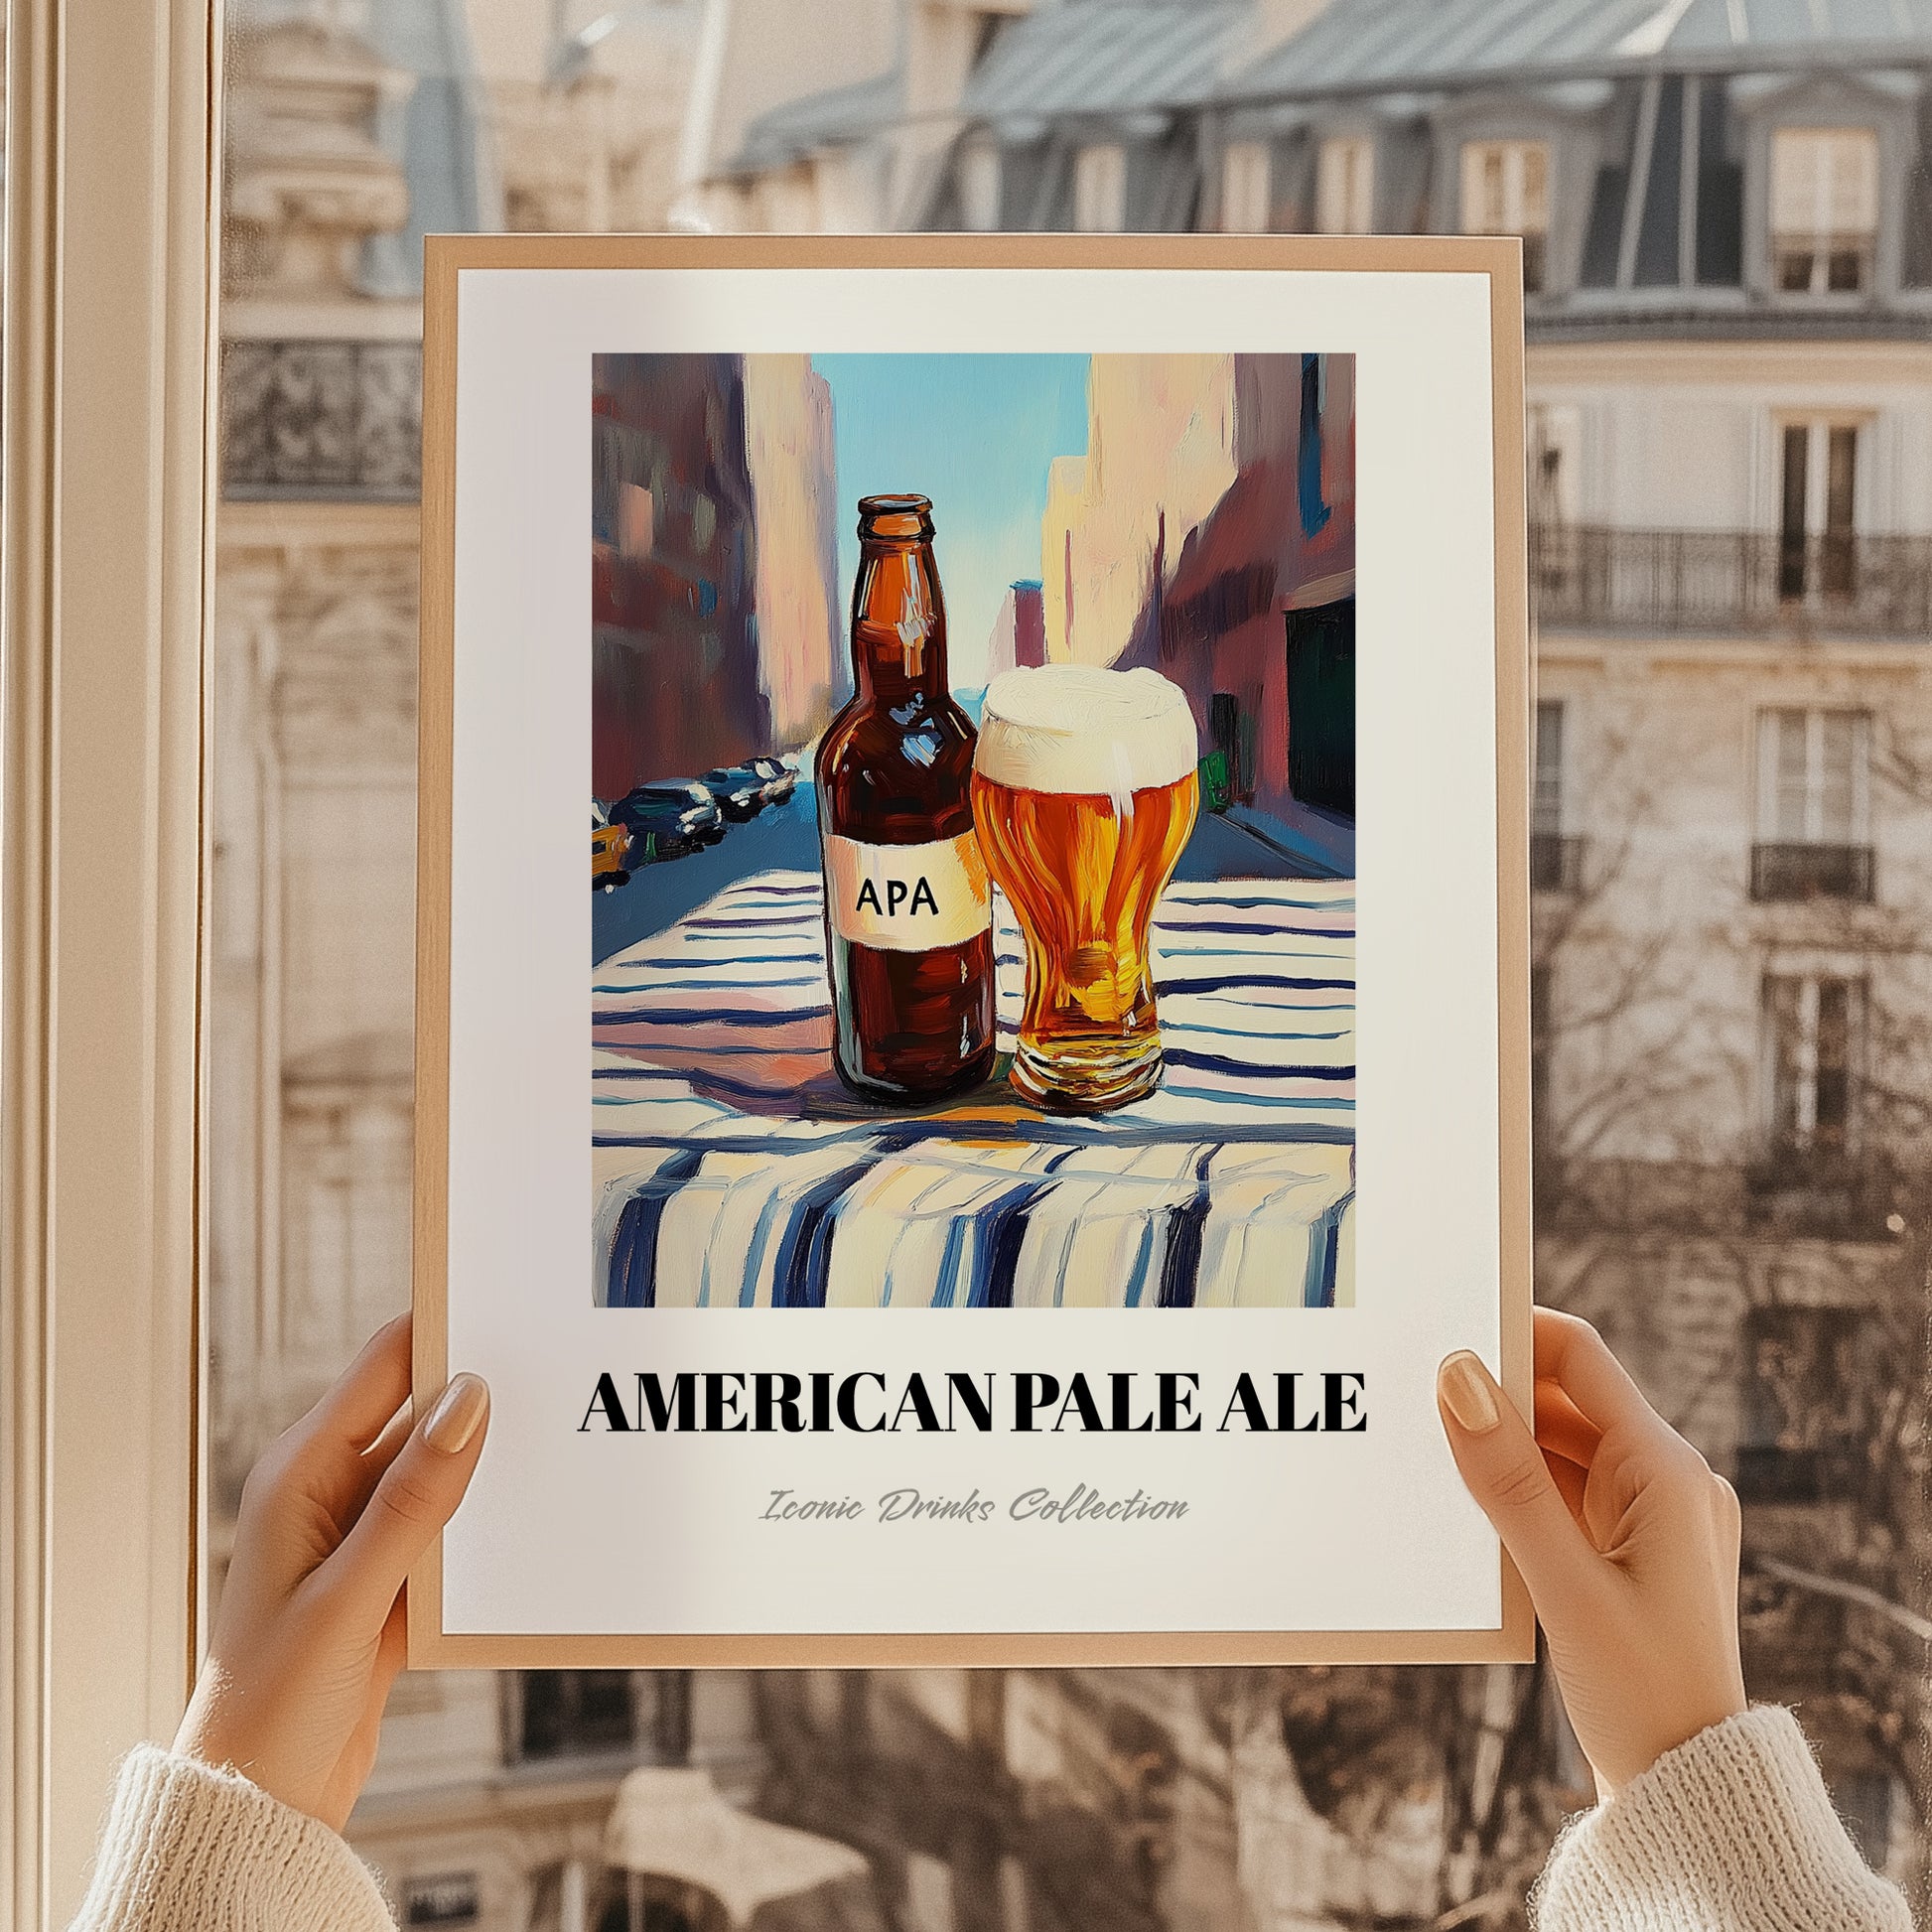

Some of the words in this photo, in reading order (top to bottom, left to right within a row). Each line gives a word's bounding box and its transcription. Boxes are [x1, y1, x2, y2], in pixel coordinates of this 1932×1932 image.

[856, 876, 939, 917] APA
[578, 1372, 996, 1433] AMERICAN
[1011, 1372, 1202, 1433] PALE
[1216, 1372, 1368, 1433] ALE
[758, 1489, 867, 1522] Iconic
[878, 1487, 996, 1524] Drinks
[1009, 1481, 1190, 1524] Collection
